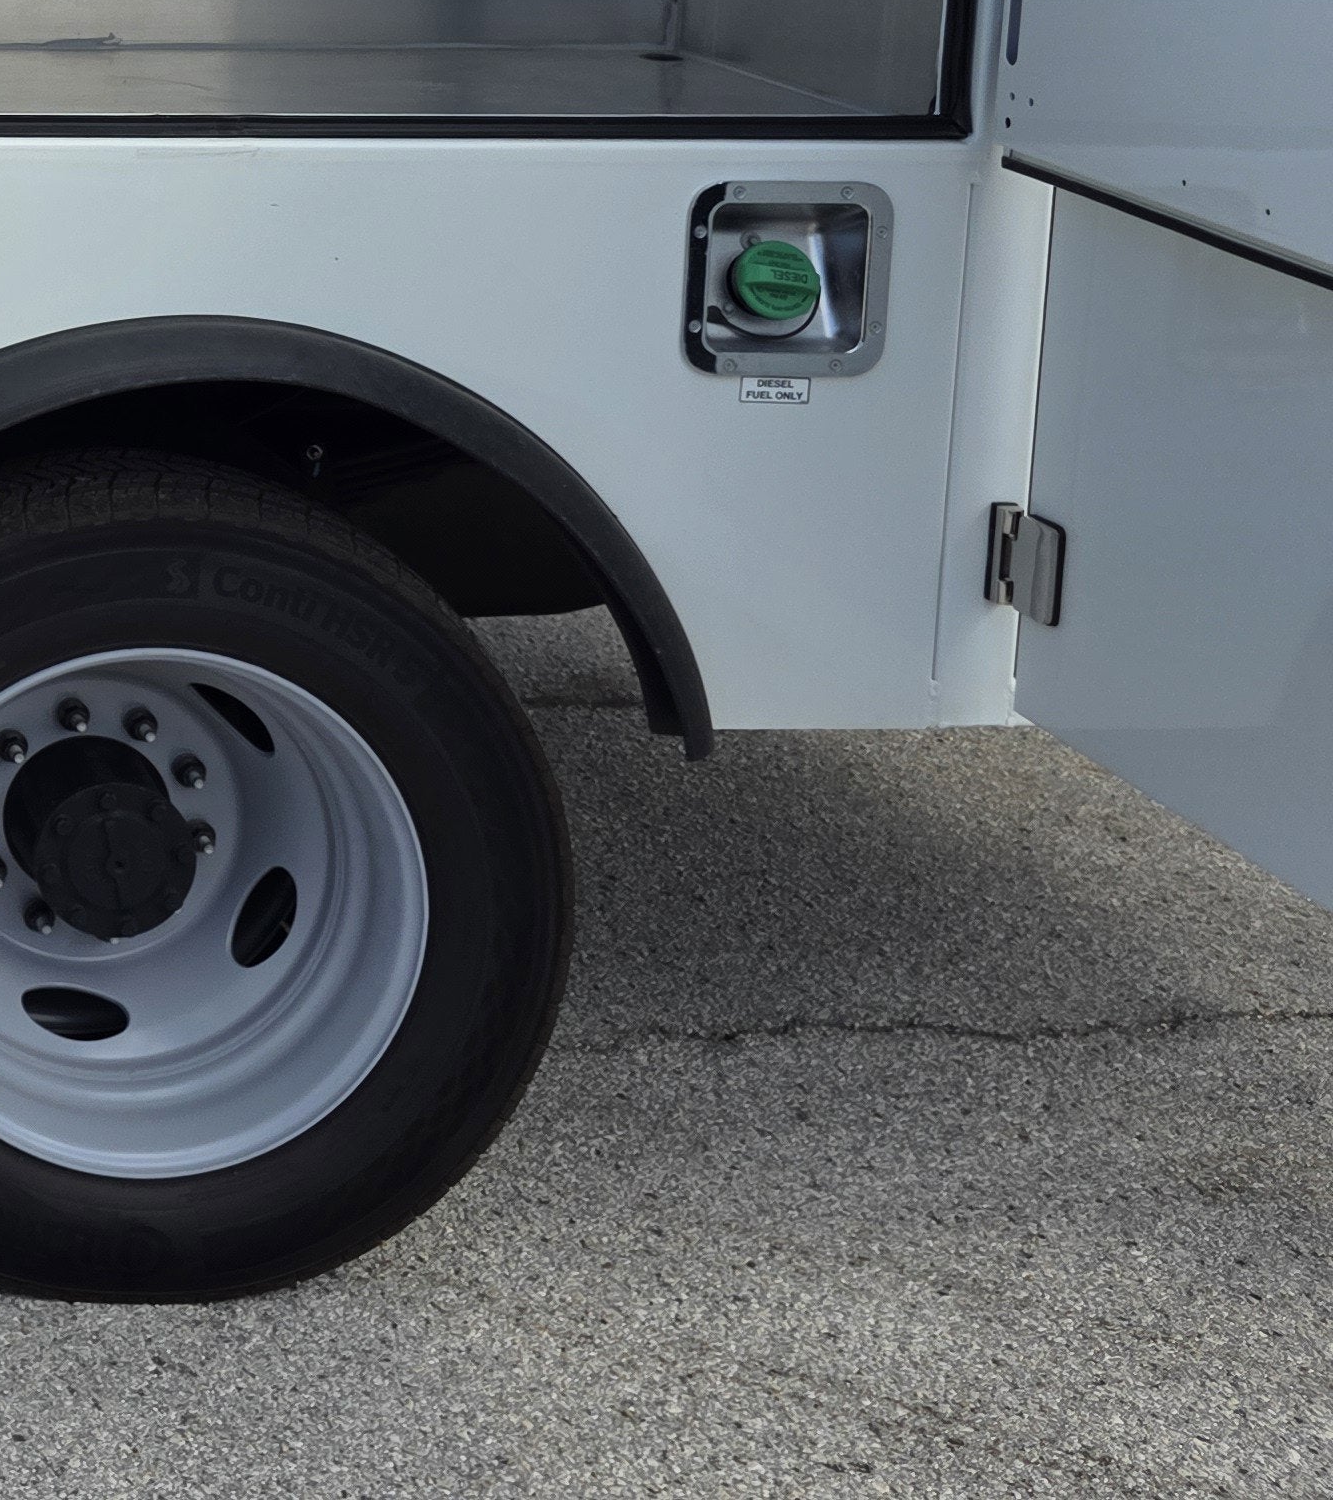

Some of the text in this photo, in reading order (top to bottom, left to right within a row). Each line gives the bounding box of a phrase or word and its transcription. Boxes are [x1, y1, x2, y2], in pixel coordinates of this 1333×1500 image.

[757, 379, 794, 388] DIESEL
[746, 390, 803, 400] FUEL ONLY
[213, 565, 321, 620] Conti
